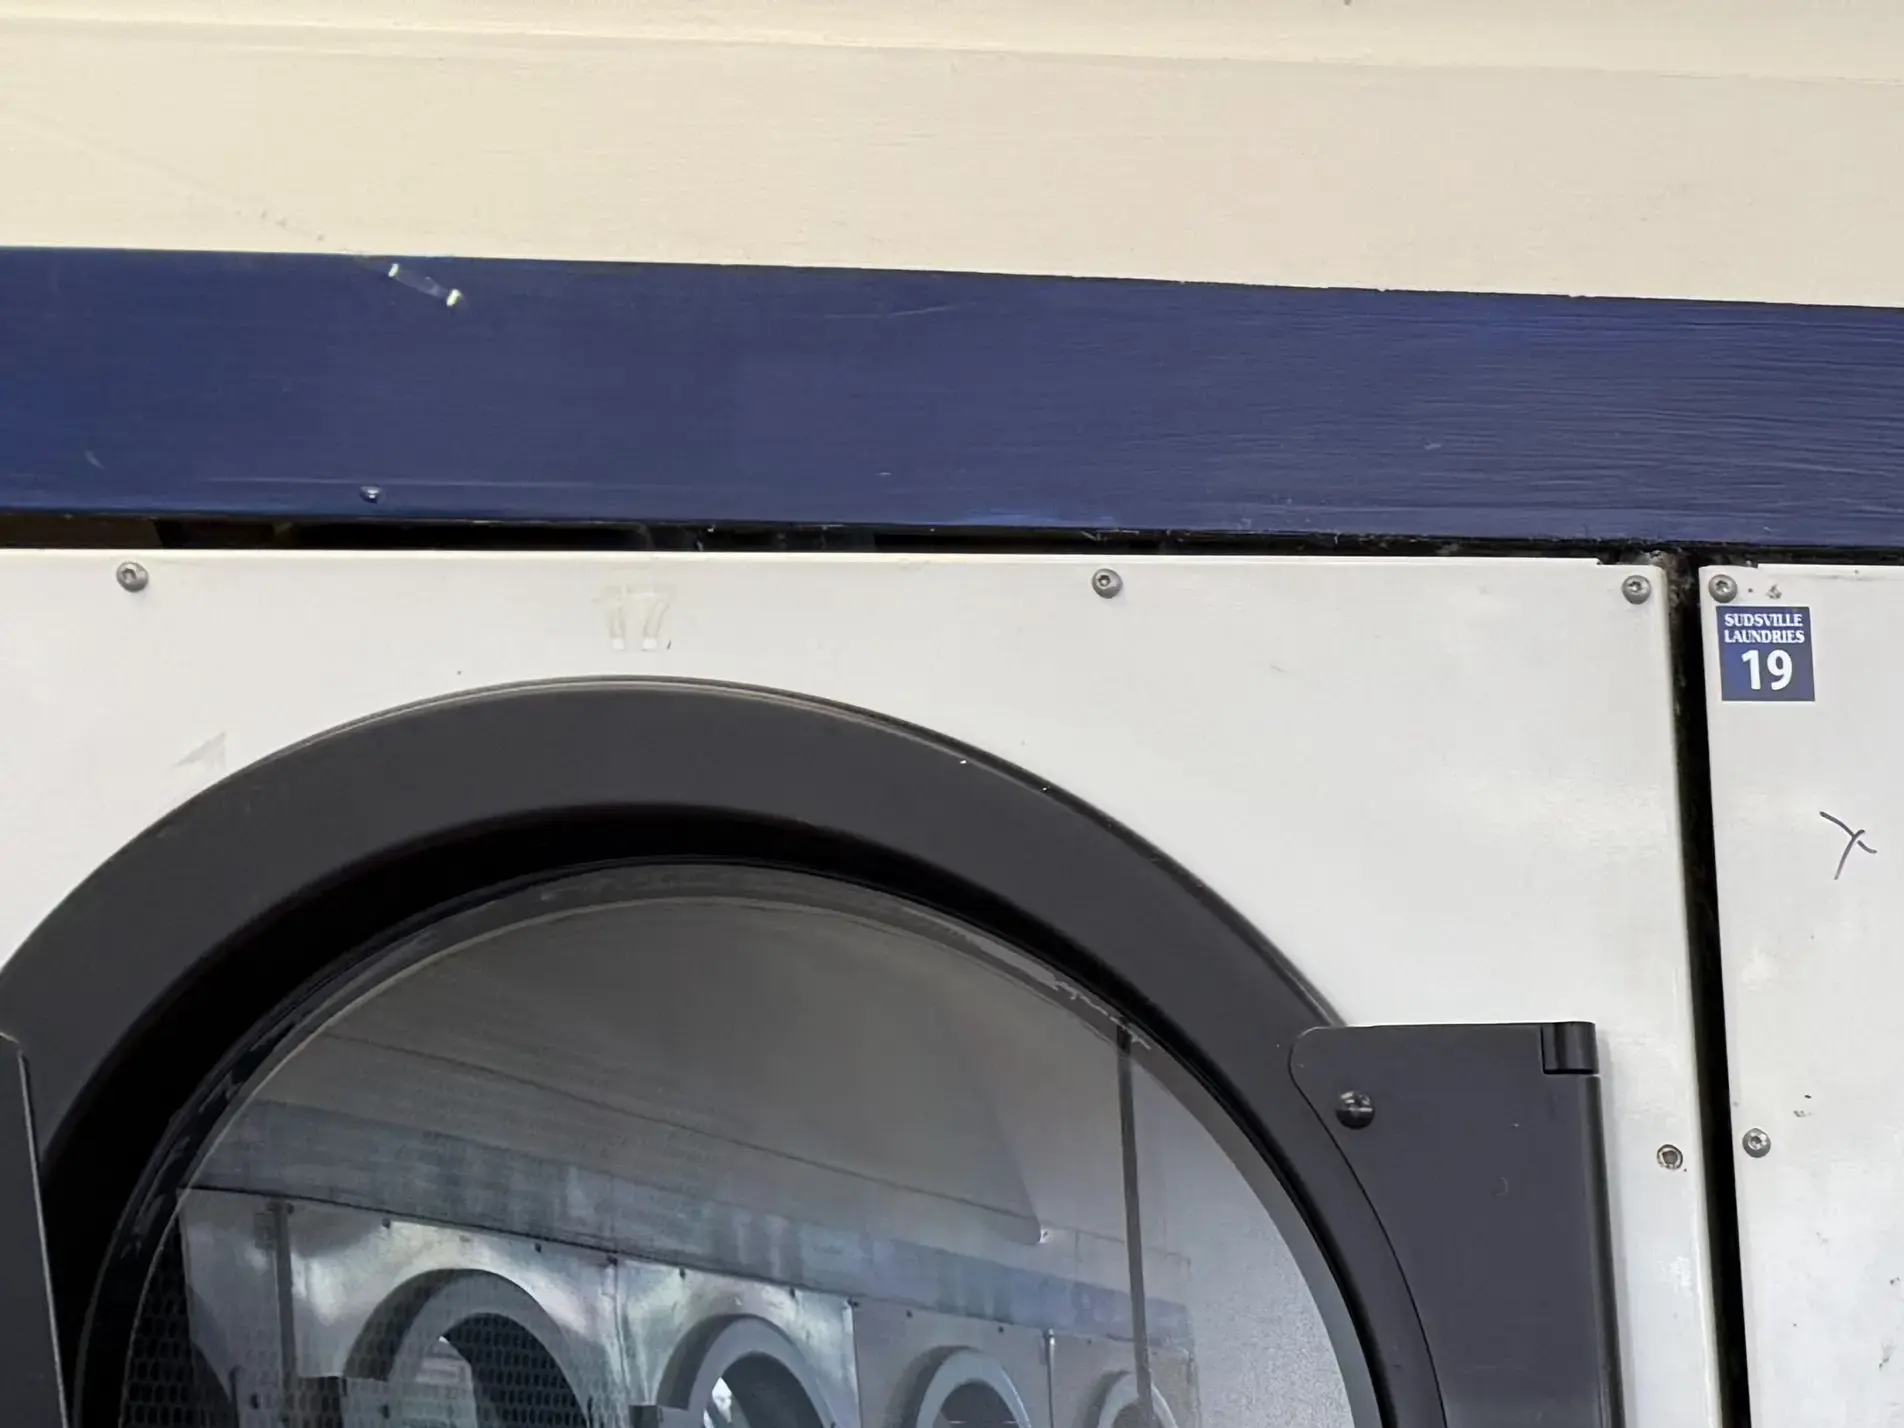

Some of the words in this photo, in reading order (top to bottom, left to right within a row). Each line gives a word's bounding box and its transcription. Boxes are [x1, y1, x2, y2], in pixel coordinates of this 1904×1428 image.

[1724, 613, 1804, 627] SUDSVILLE
[1724, 629, 1805, 644] LAUNDRIES
[1741, 649, 1793, 691] 19
